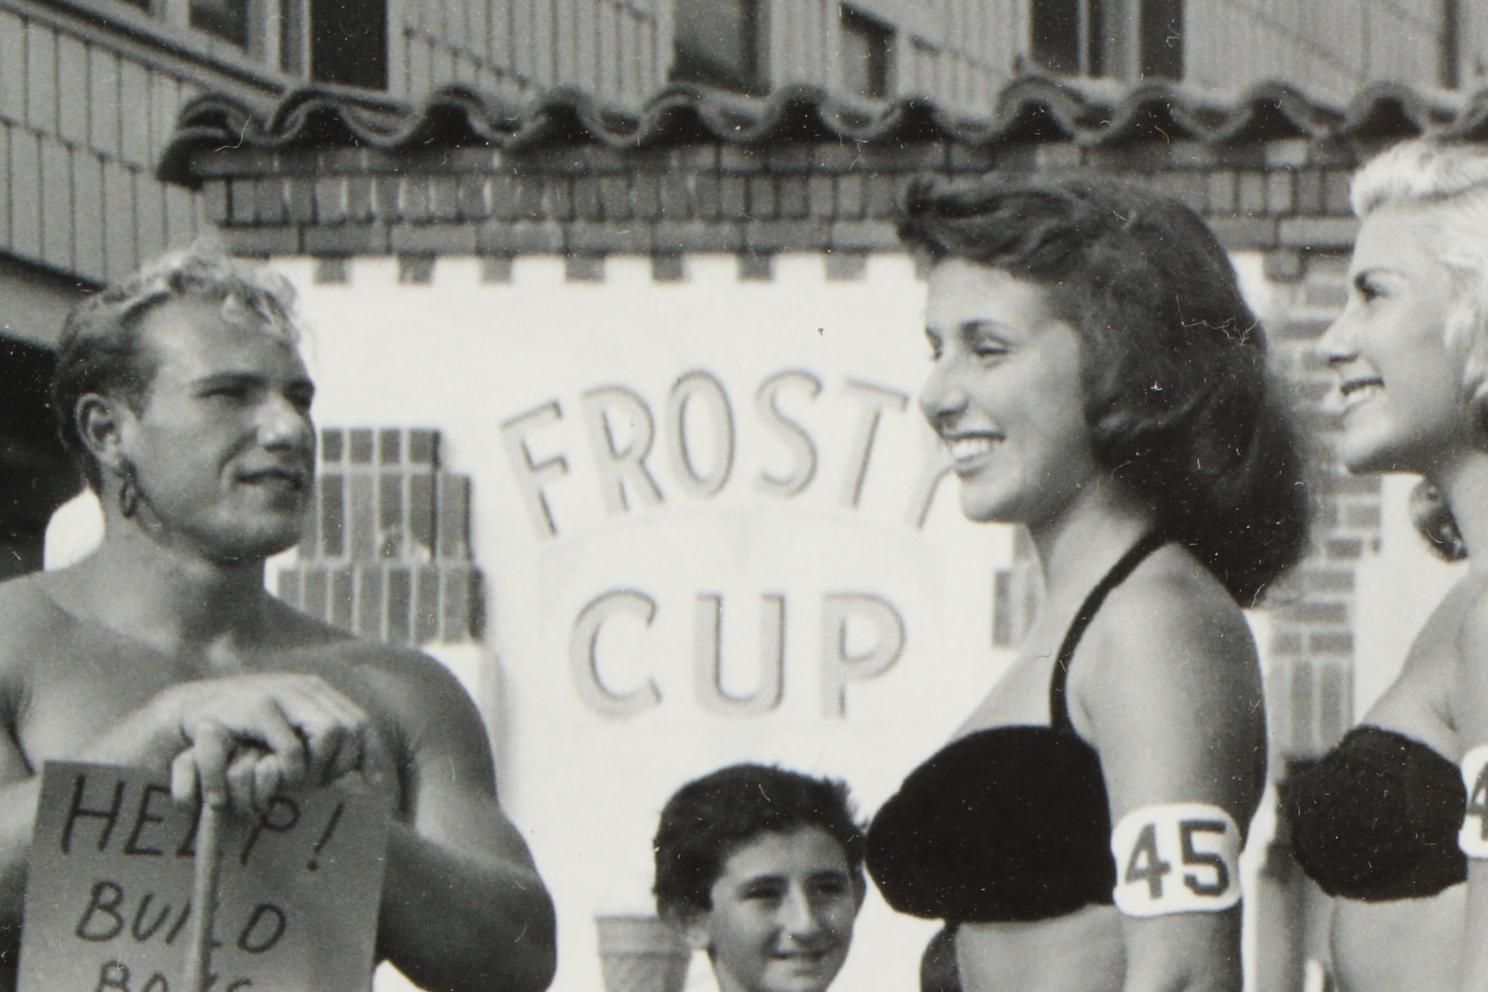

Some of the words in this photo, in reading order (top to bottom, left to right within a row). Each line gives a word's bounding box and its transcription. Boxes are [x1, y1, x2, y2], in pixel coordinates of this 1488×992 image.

[569, 588, 907, 720] CUP
[1125, 819, 1230, 899] 45
[75, 880, 287, 954] BUID
